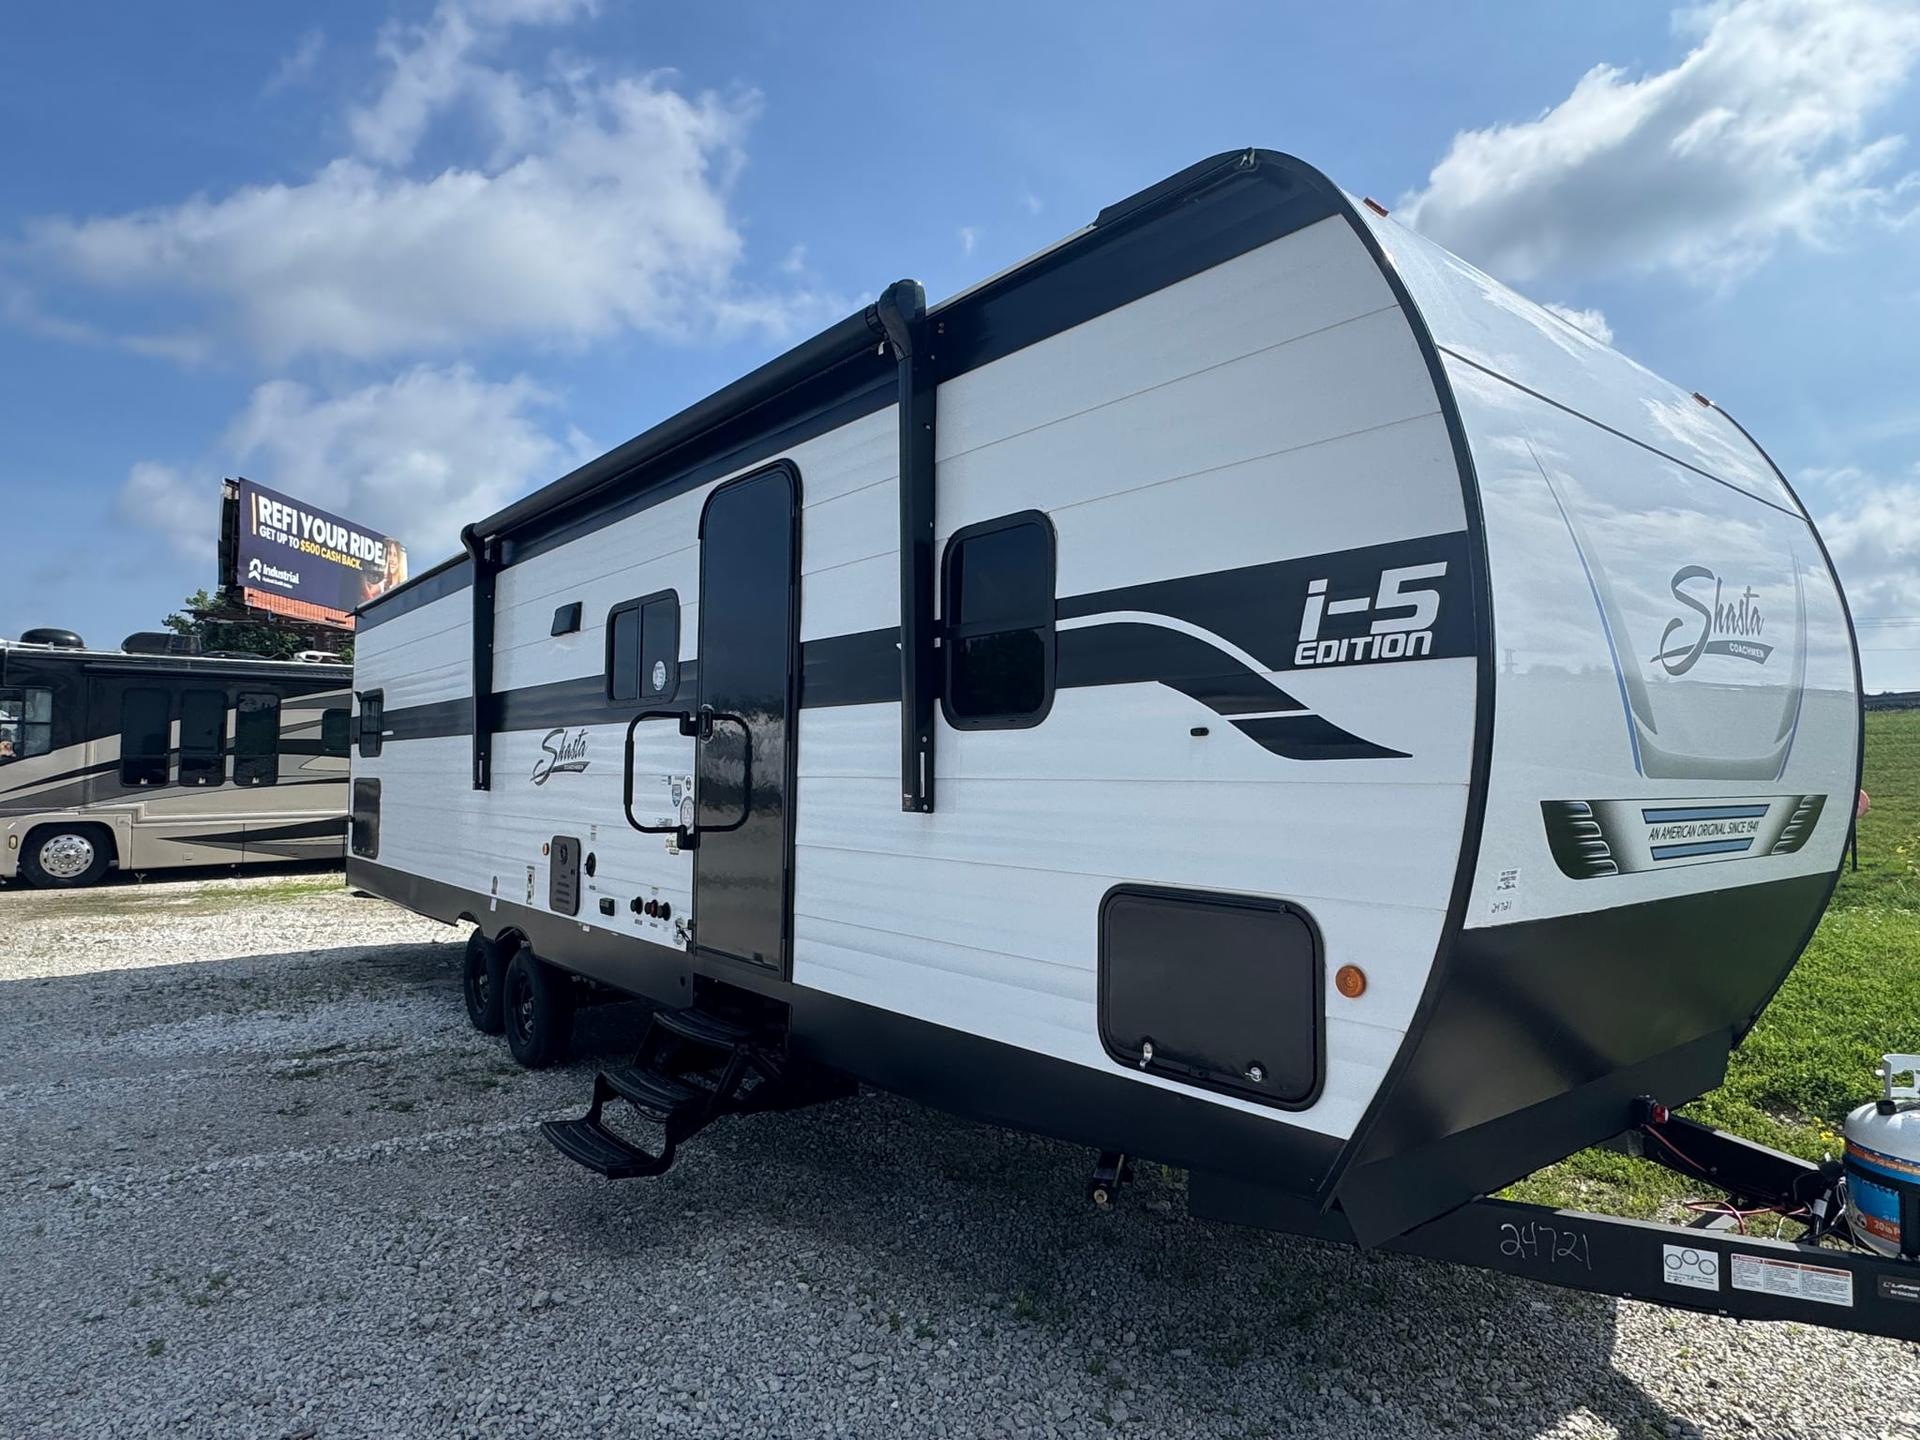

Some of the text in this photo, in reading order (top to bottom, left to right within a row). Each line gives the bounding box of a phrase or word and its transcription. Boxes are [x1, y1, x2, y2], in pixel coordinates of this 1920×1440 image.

[258, 495, 298, 535] REFI
[300, 511, 348, 553] YOUR
[260, 525, 276, 540] GET
[277, 531, 288, 544] UP
[289, 535, 300, 549] TO
[300, 539, 321, 556] $500
[321, 547, 341, 563] CASH
[263, 563, 300, 584] Industrial
[1298, 561, 1448, 641] i-5
[1659, 565, 1766, 676] Shasta
[1294, 630, 1433, 666] EDITION
[531, 728, 590, 786] Shasta
[1648, 827, 1660, 841] AN
[1660, 824, 1696, 840] AMERICAN
[1696, 822, 1726, 837] ORIGINAL
[1727, 820, 1747, 834] SINCE
[1500, 1221, 1592, 1271] 24721
